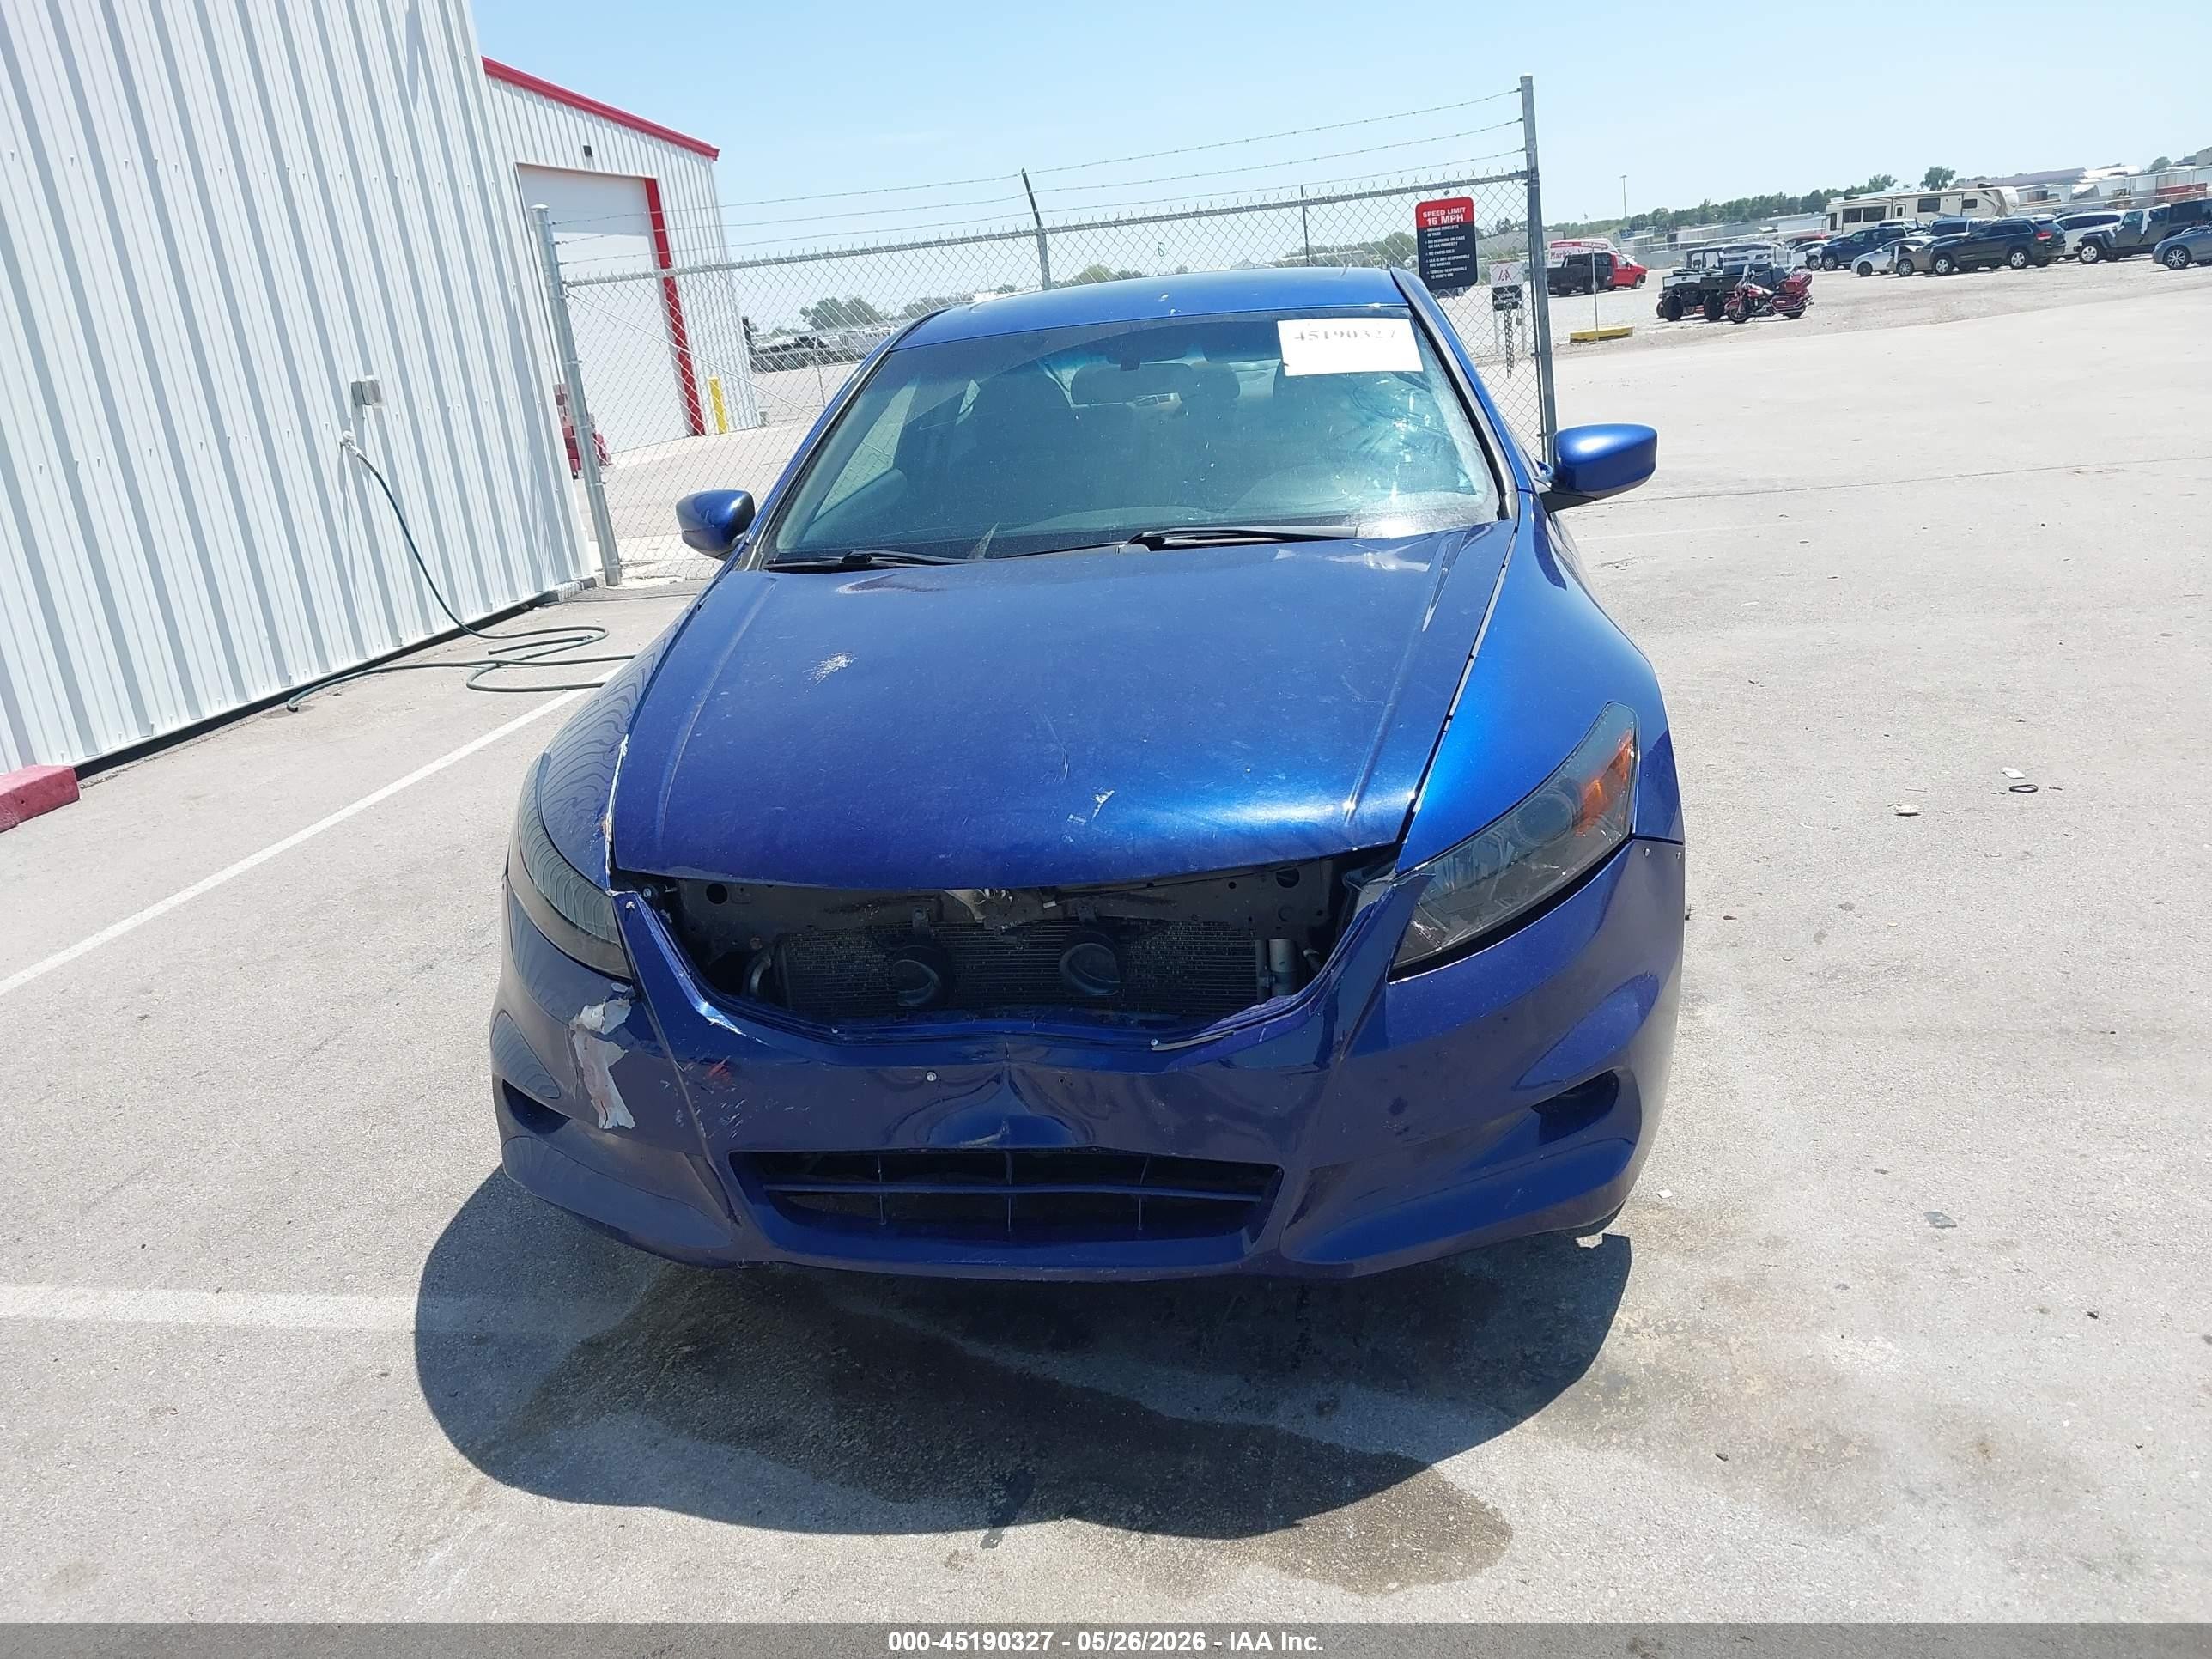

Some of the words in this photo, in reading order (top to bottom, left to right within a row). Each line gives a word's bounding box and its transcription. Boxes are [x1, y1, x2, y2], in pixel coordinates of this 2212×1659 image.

[1423, 210, 1445, 218] SPEED
[1427, 217, 1437, 226] 15
[1441, 214, 1463, 224] MPH
[1294, 329, 1395, 341] 45190327
